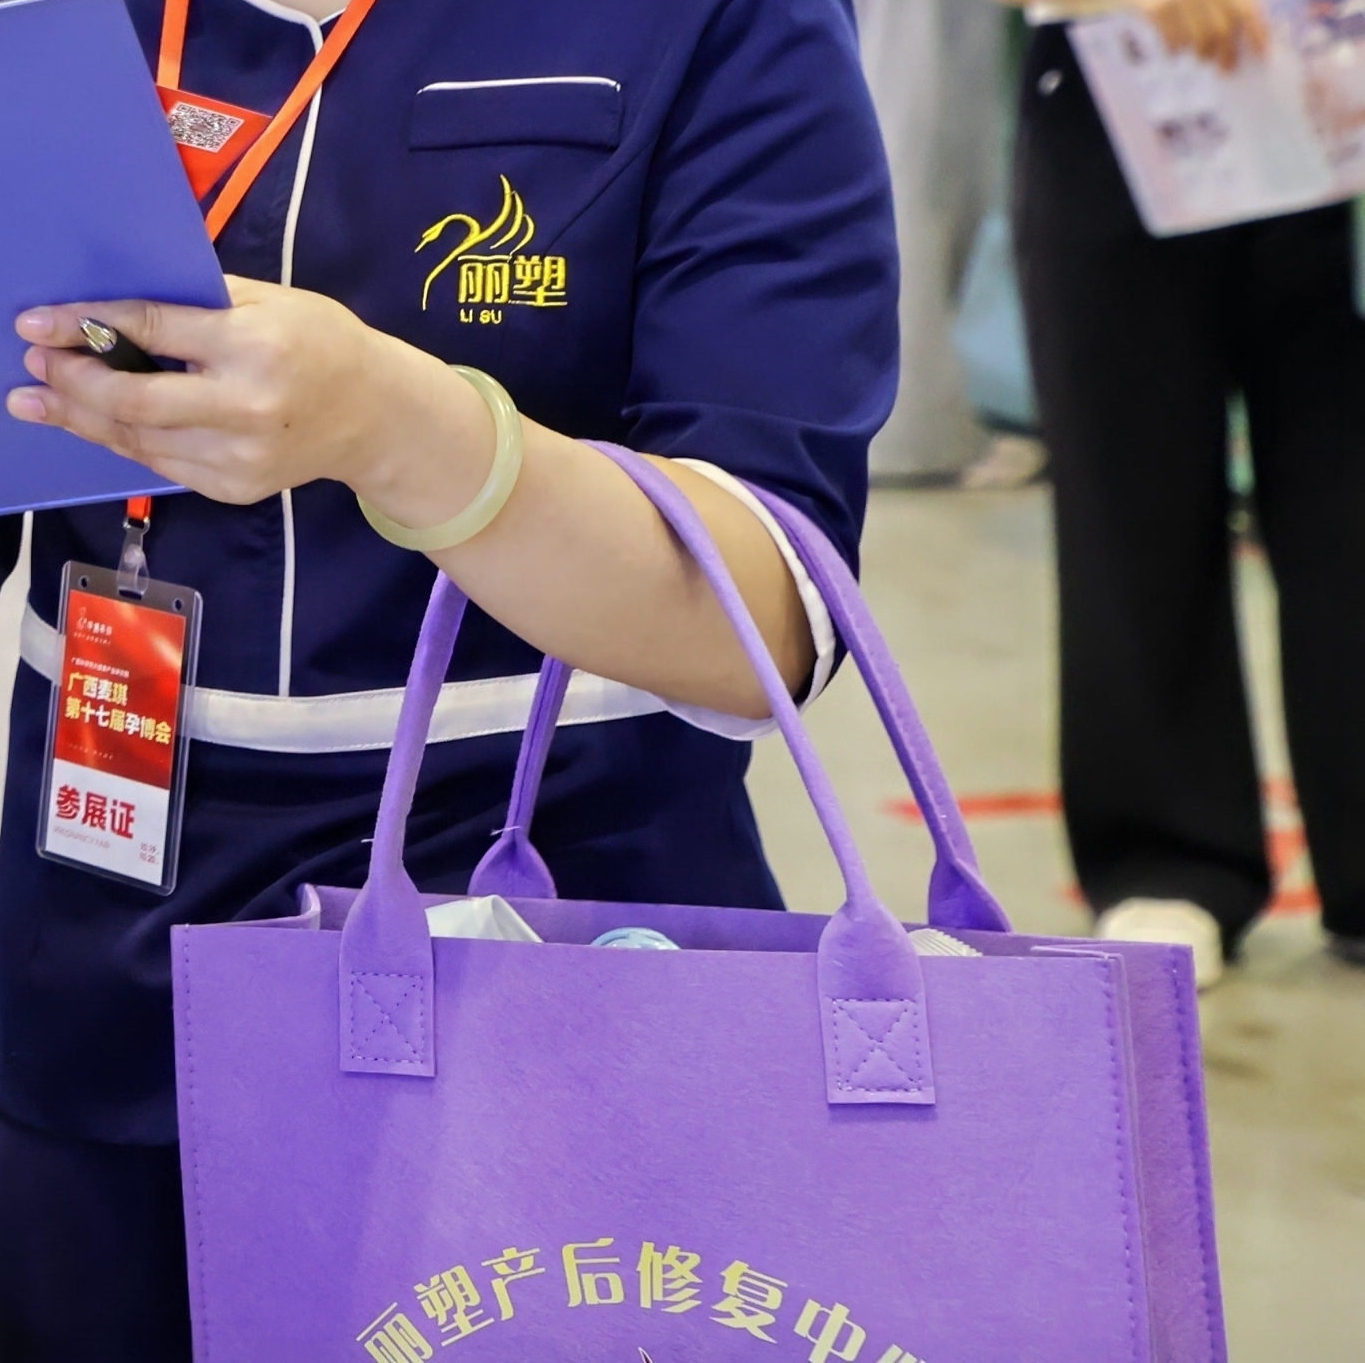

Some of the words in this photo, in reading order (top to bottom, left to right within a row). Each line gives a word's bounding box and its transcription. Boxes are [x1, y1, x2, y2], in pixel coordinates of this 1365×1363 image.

[458, 255, 568, 307] 丽塑
[67, 671, 129, 706] 广西麦琪
[65, 696, 172, 744] 第十七届孕博会
[56, 783, 136, 840] 参展证
